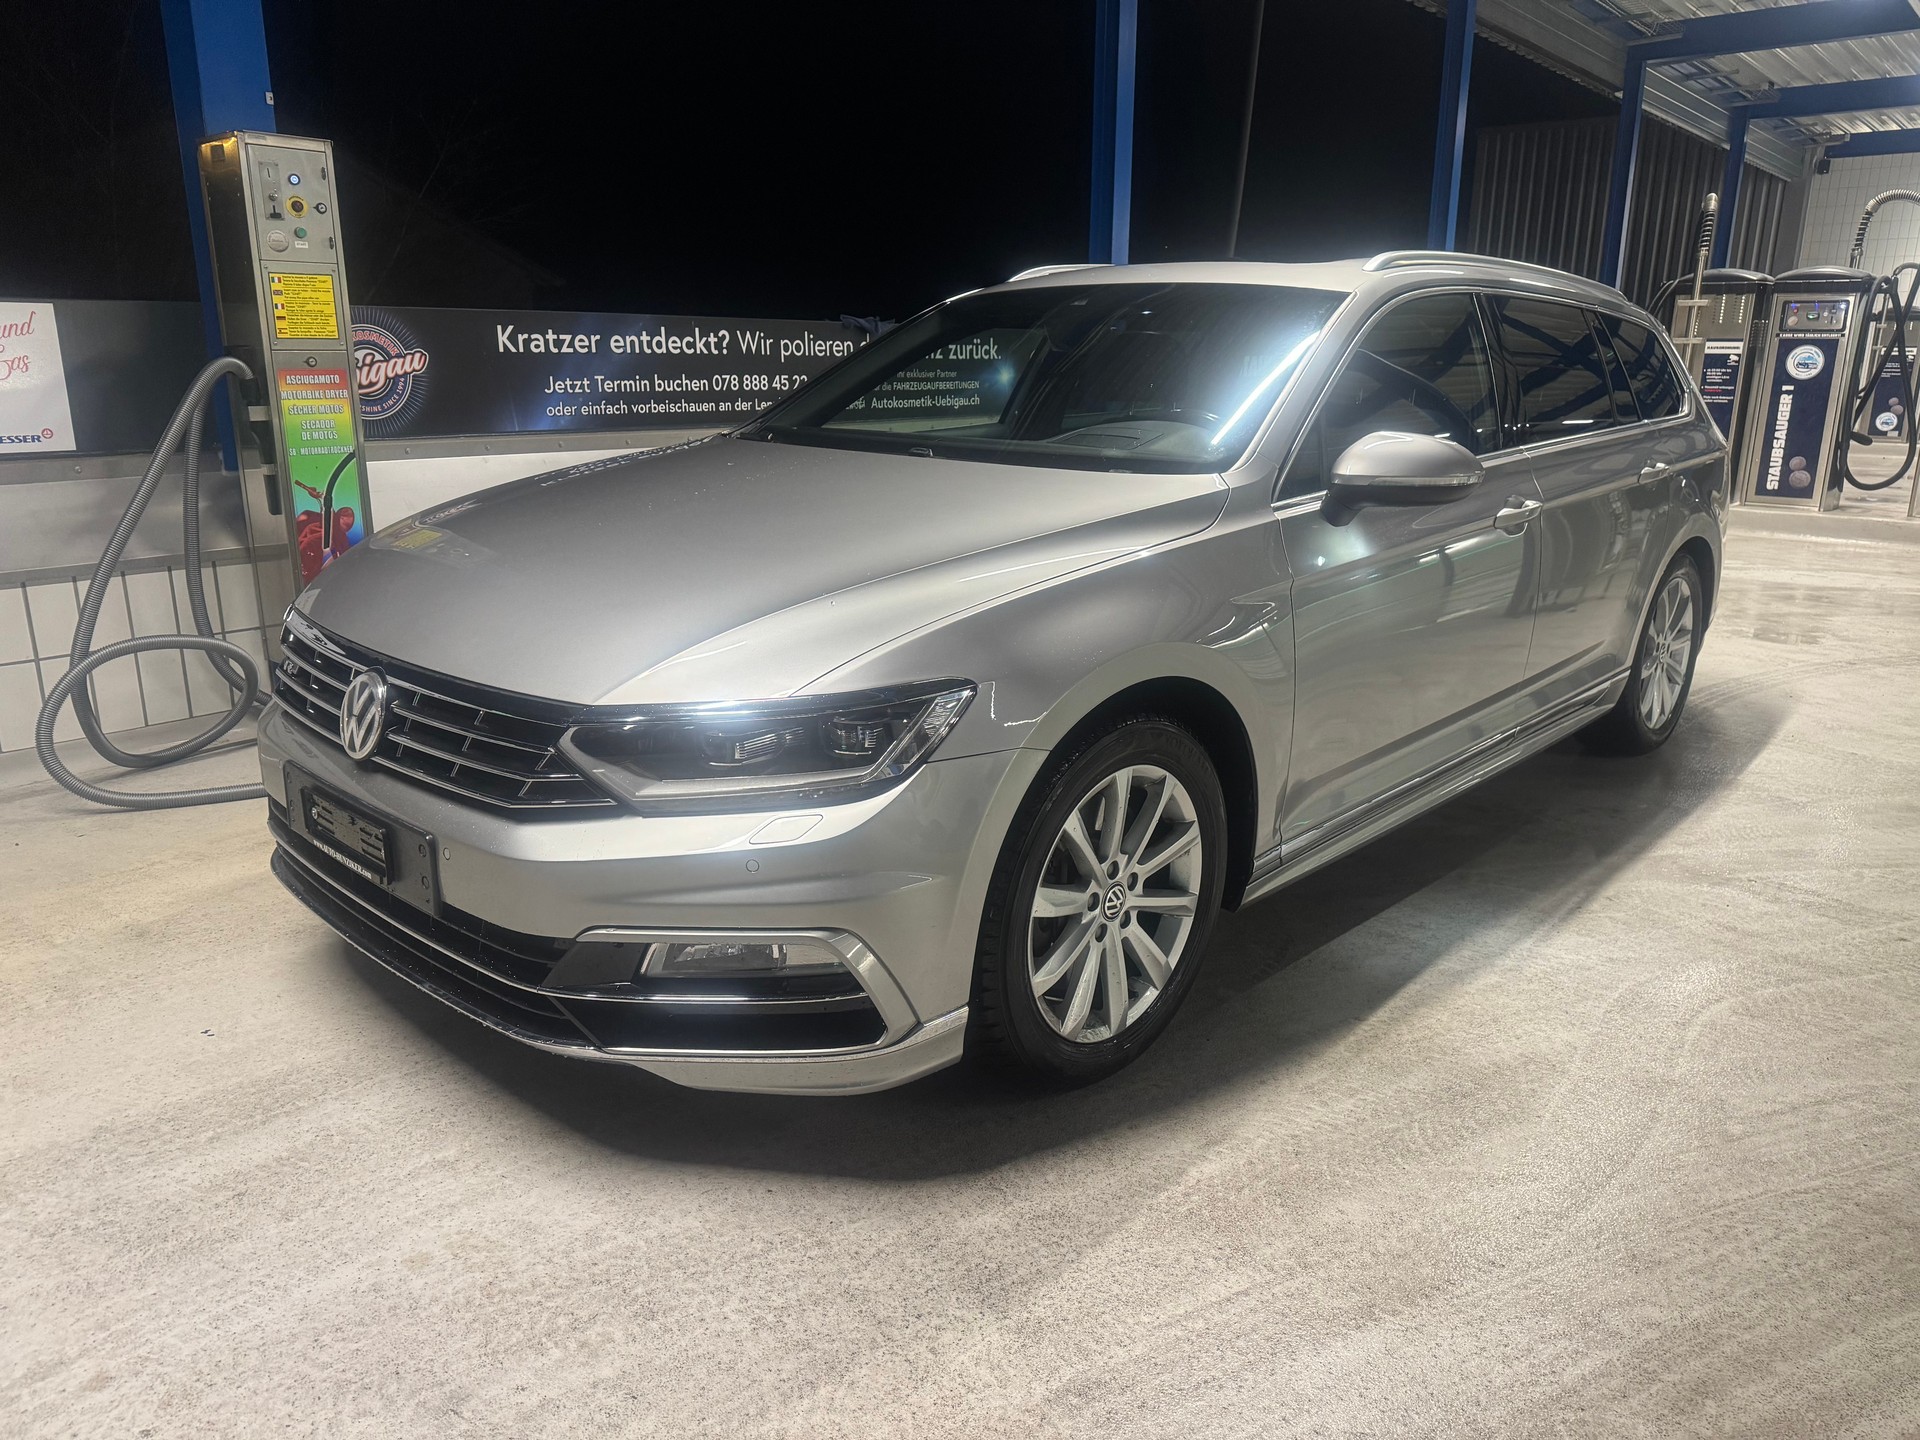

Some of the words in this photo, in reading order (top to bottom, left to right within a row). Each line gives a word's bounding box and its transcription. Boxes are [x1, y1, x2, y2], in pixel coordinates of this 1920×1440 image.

[496, 324, 600, 353] Kratzer
[610, 326, 730, 355] entdeckt?
[736, 330, 773, 356] Wir
[780, 331, 854, 363] polieren
[948, 337, 1002, 360] zurück.
[286, 374, 340, 385] ASCIUGAMOTO
[356, 350, 427, 394] igau
[906, 369, 935, 379] exklusiver
[936, 368, 957, 378] Partner
[544, 375, 590, 394] Jetzt
[594, 375, 650, 393] Termin
[654, 373, 709, 392] buchen
[712, 374, 739, 391] 078
[743, 374, 769, 391] 888
[772, 374, 789, 390] 45
[881, 381, 892, 391] die
[893, 380, 980, 390] FAHRZEUGAUFBEREITUNGEN
[280, 390, 324, 400] MOTORBIKE
[325, 389, 348, 398] DRYER
[384, 395, 399, 409] SINCE
[397, 377, 405, 394] 1994
[871, 393, 980, 409] Autokosmetik-Uebigau.ch
[319, 404, 344, 414] MOTOS
[546, 401, 577, 416] oder
[581, 400, 628, 415] einfach
[631, 398, 715, 414] vorbeischauen
[718, 402, 731, 412] an
[734, 397, 752, 411] der
[301, 419, 336, 429] SECADOR
[301, 431, 311, 441] DE
[312, 430, 338, 440] MOTOS
[1766, 393, 1794, 491] STAUBSAUGER
